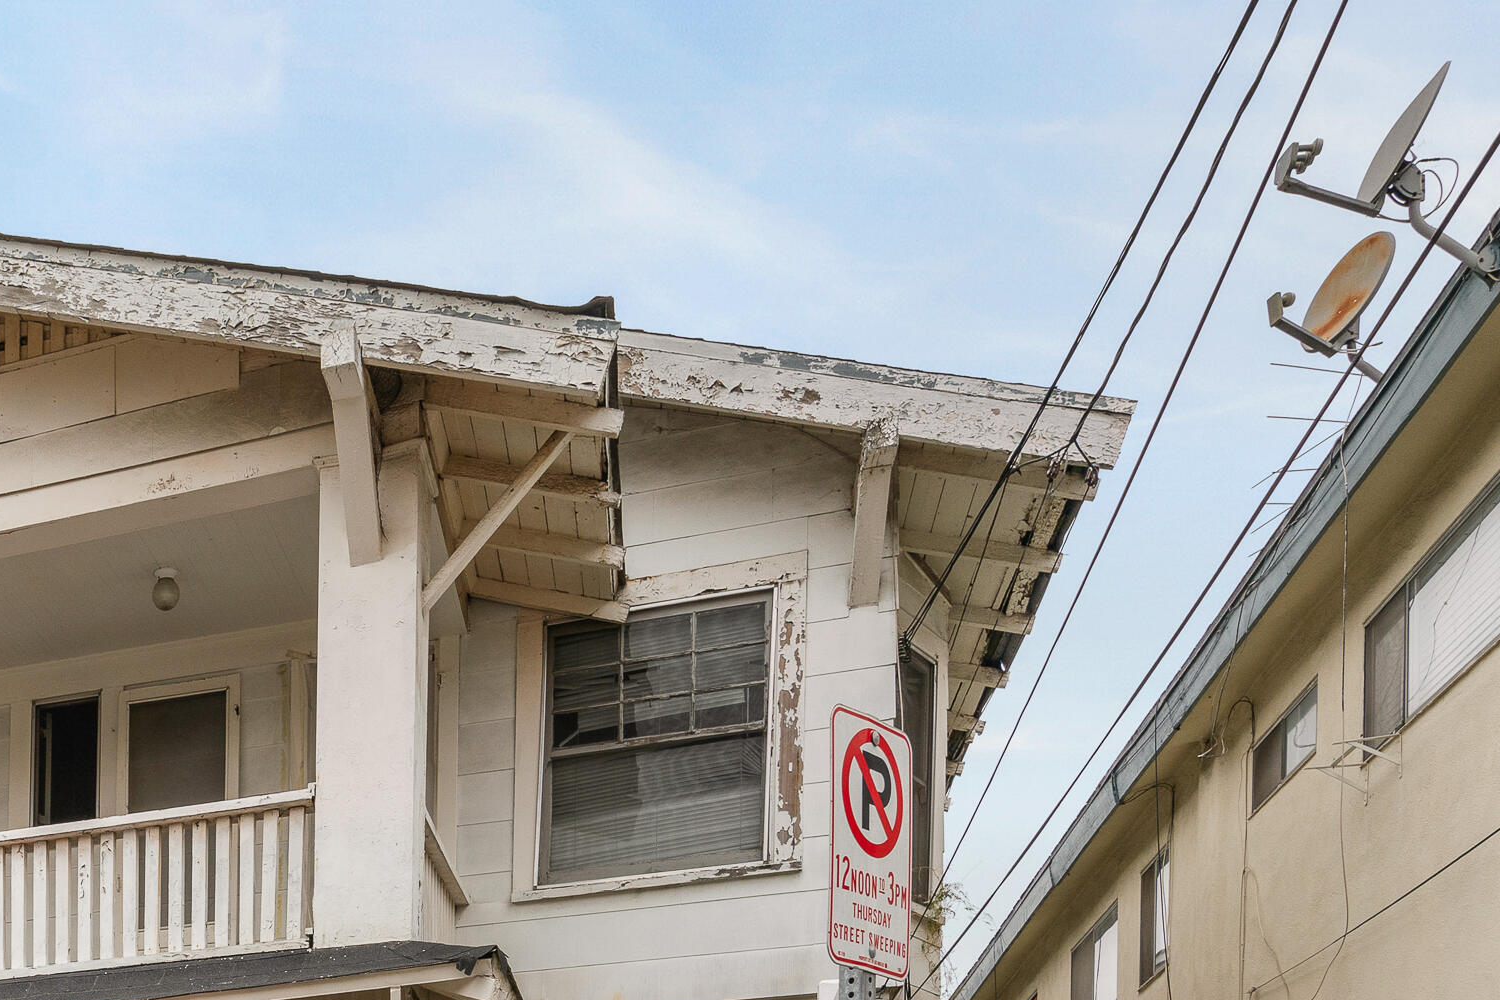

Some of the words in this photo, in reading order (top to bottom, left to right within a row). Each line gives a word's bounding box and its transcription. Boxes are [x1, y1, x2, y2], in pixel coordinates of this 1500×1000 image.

[879, 877, 886, 894] TO
[852, 902, 892, 929] THURSDAY
[833, 922, 866, 945] STREET
[868, 931, 907, 958] SWEEPING
